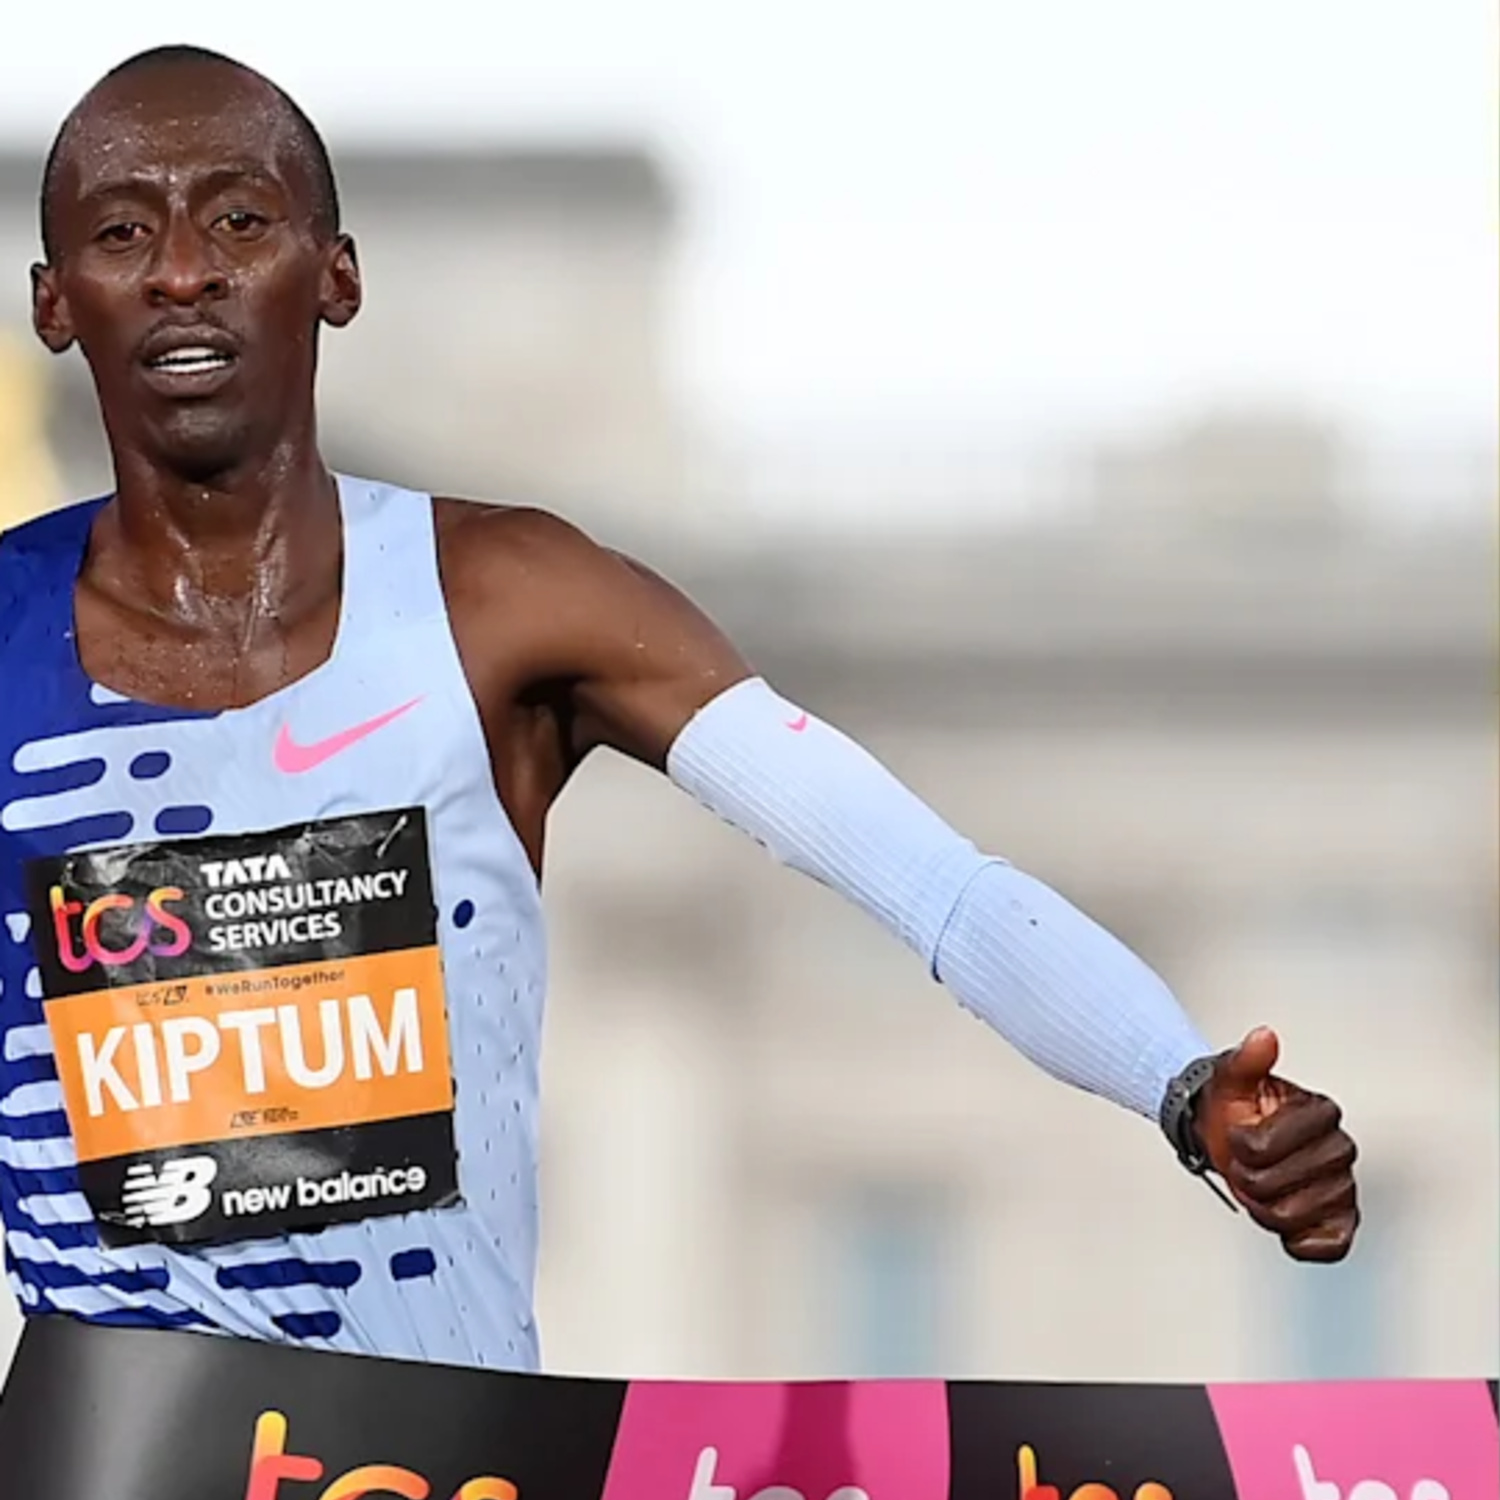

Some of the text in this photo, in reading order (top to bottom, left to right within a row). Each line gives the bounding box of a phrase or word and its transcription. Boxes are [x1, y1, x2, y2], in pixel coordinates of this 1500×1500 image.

[200, 854, 291, 887] TATA
[205, 869, 407, 920] CONSULTANCY
[49, 886, 193, 973] tcs
[208, 911, 342, 951] SERVICES
[76, 988, 424, 1117] KIPTUM
[222, 1166, 427, 1216] new balance
